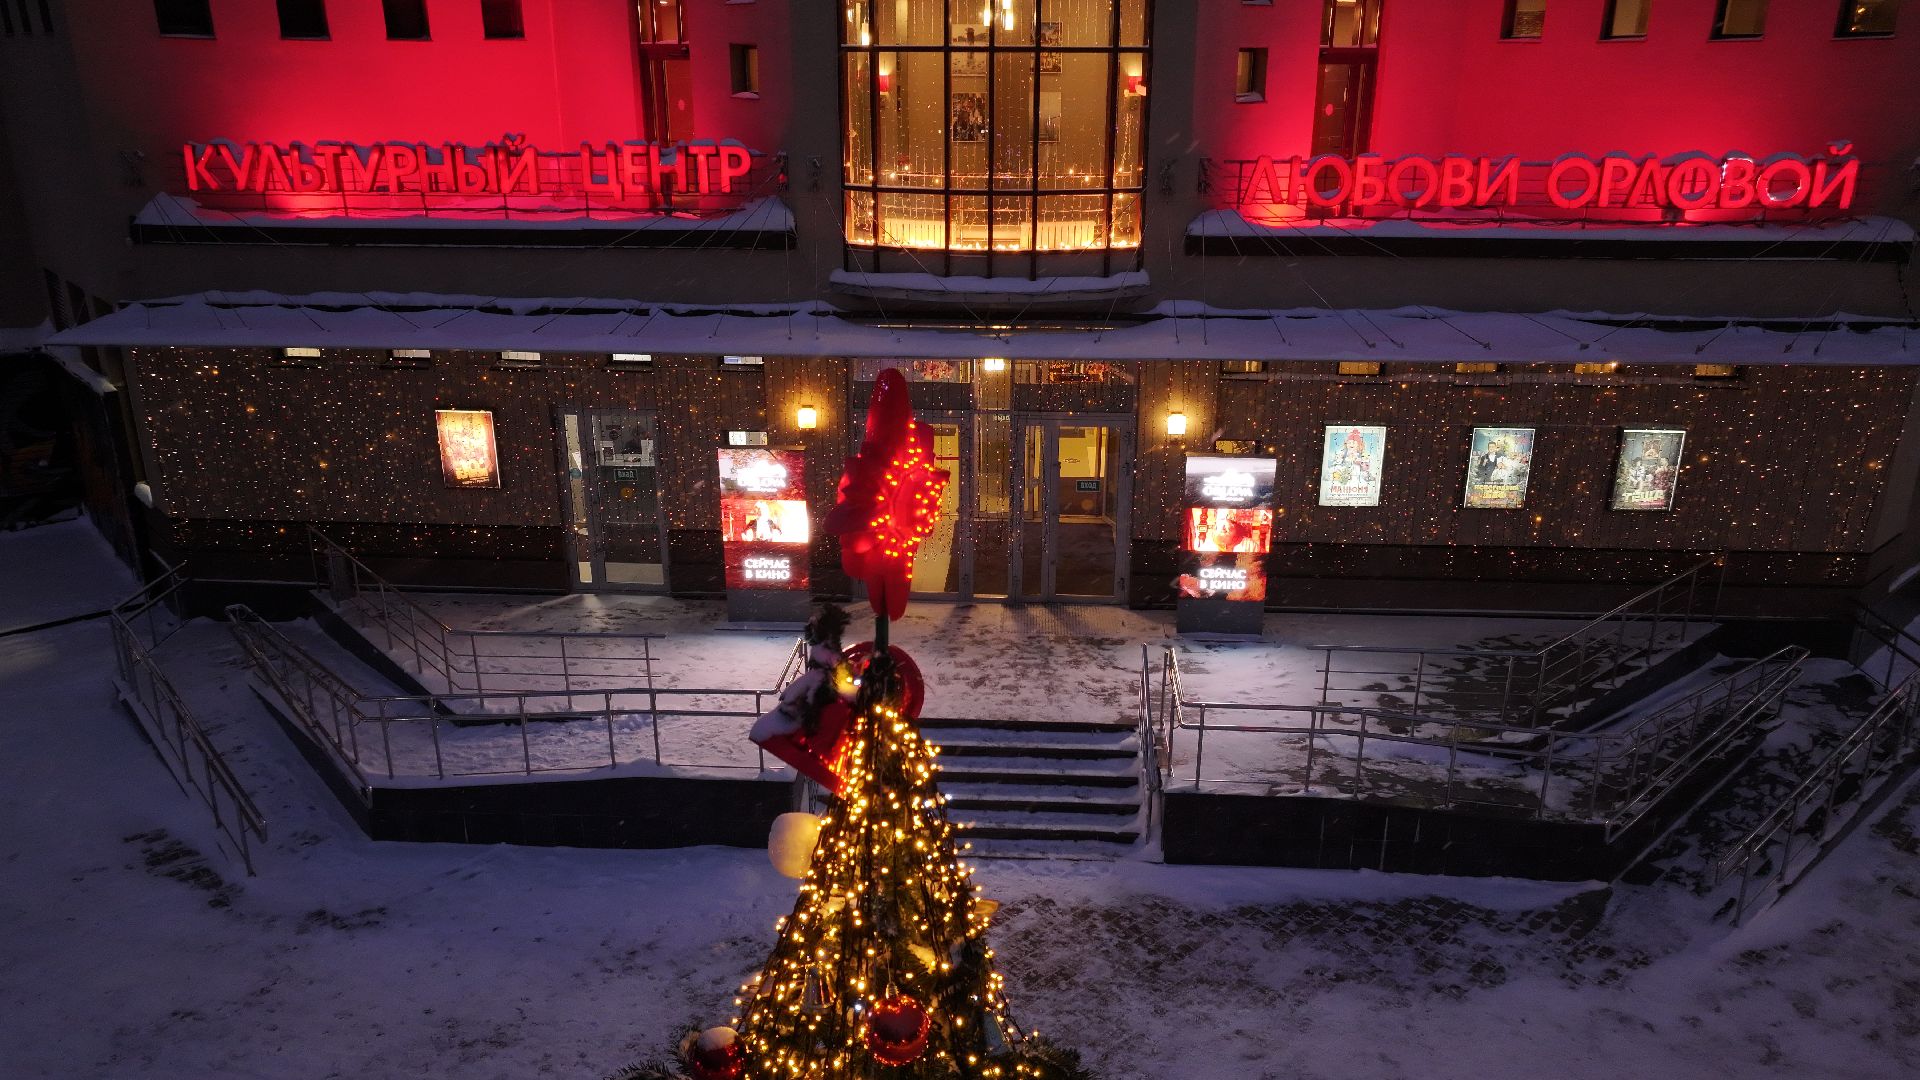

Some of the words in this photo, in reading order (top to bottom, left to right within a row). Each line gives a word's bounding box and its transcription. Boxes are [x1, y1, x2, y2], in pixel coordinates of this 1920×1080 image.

[183, 136, 538, 195] КУЛЬТУРНЫЙ
[580, 142, 752, 201] ЦЕНТР
[1241, 155, 1520, 209] ЛЮБОВИ
[1547, 141, 1860, 210] ОРЛОВОЙ
[744, 558, 790, 569] СЕЙЧАС
[744, 569, 753, 579] В
[755, 569, 790, 580] КИНО
[1200, 567, 1247, 579] СЕЙЧАС
[1210, 579, 1247, 590] КИНО
